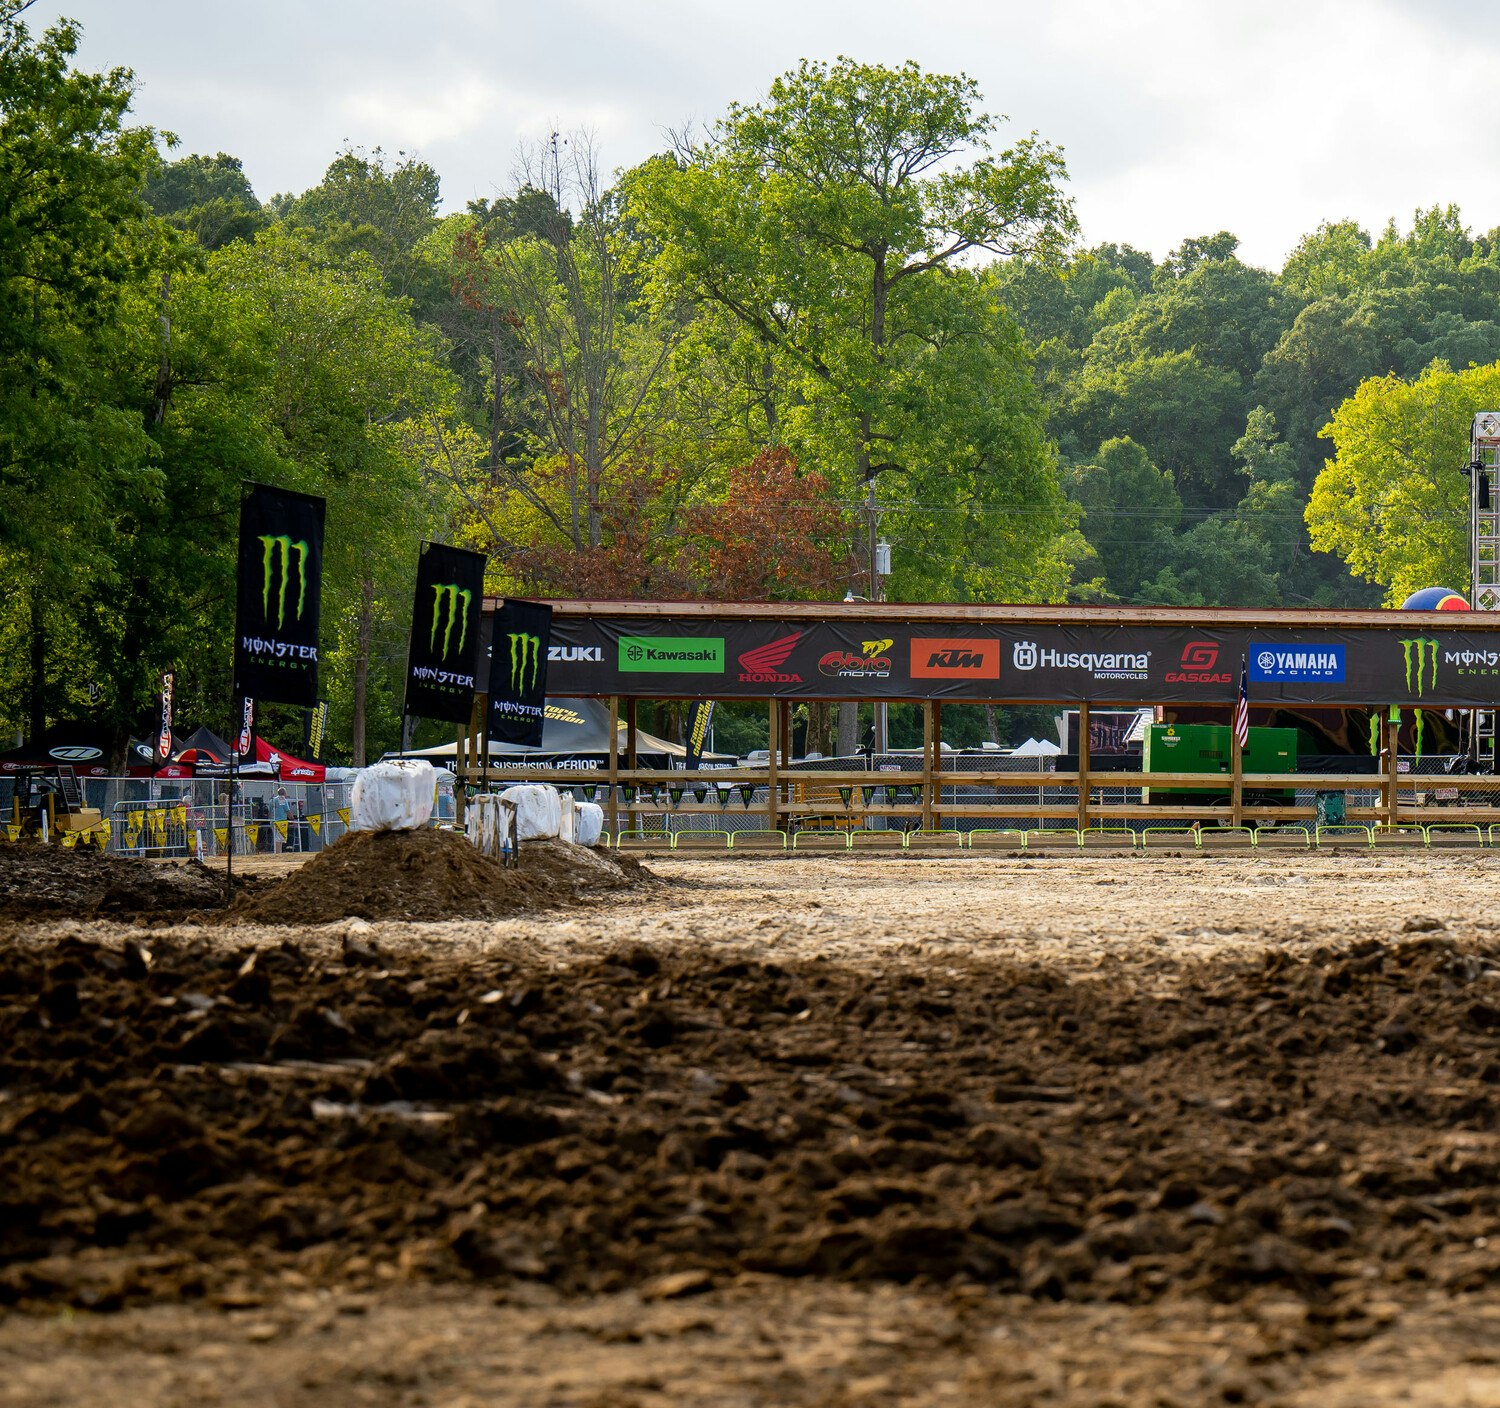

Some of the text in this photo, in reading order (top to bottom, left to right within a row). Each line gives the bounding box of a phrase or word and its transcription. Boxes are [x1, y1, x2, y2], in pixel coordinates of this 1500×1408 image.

[243, 636, 318, 662] MONSTER
[547, 646, 602, 662] ZUKI
[646, 648, 717, 661] Kawasaki
[250, 656, 309, 671] ENERGY
[818, 650, 892, 677] Cobra
[926, 649, 984, 668] KTM
[1041, 649, 1148, 672] Husqvarna
[1276, 652, 1338, 670] YAMAHA
[413, 666, 474, 689] MONSTER
[738, 673, 804, 683] HONDA
[1094, 672, 1148, 680] MOTORCYCLES
[1165, 672, 1232, 683] GASGAS
[494, 700, 543, 718] MONSTER
[501, 713, 535, 724] ENERGY
